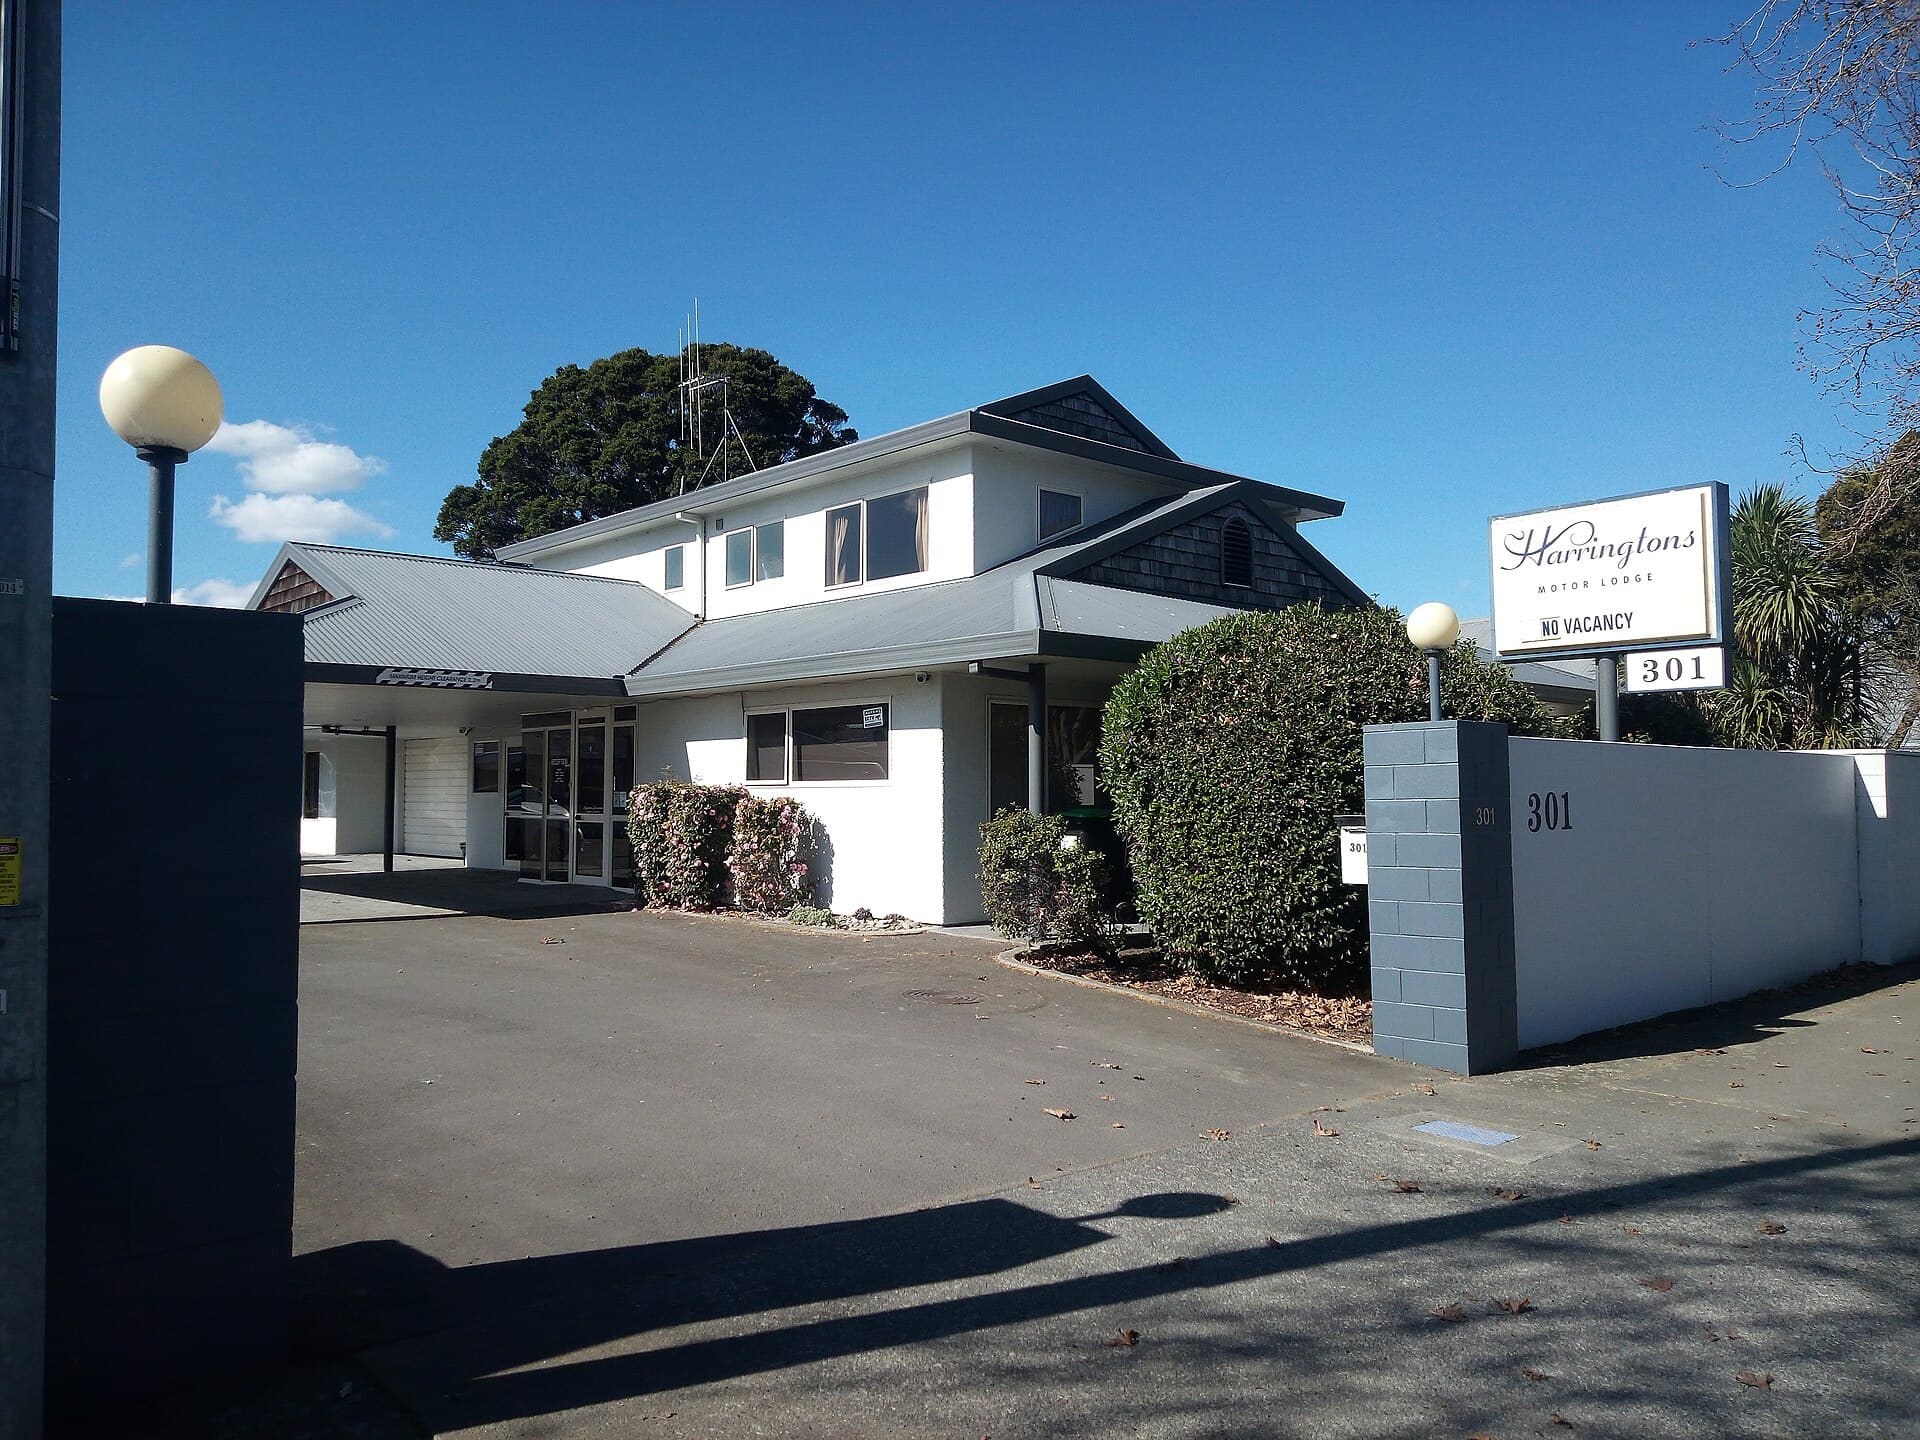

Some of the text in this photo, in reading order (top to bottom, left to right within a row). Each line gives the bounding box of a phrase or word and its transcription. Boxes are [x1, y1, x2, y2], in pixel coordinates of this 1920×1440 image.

[1500, 520, 1695, 571] Harringtons
[1538, 572, 1653, 594] MOTOR LODGE
[1541, 611, 1634, 637] NO VACANCY
[1642, 655, 1706, 683] 301
[1476, 807, 1496, 825] 301
[1527, 791, 1573, 833] 301
[1350, 843, 1367, 853] 301
